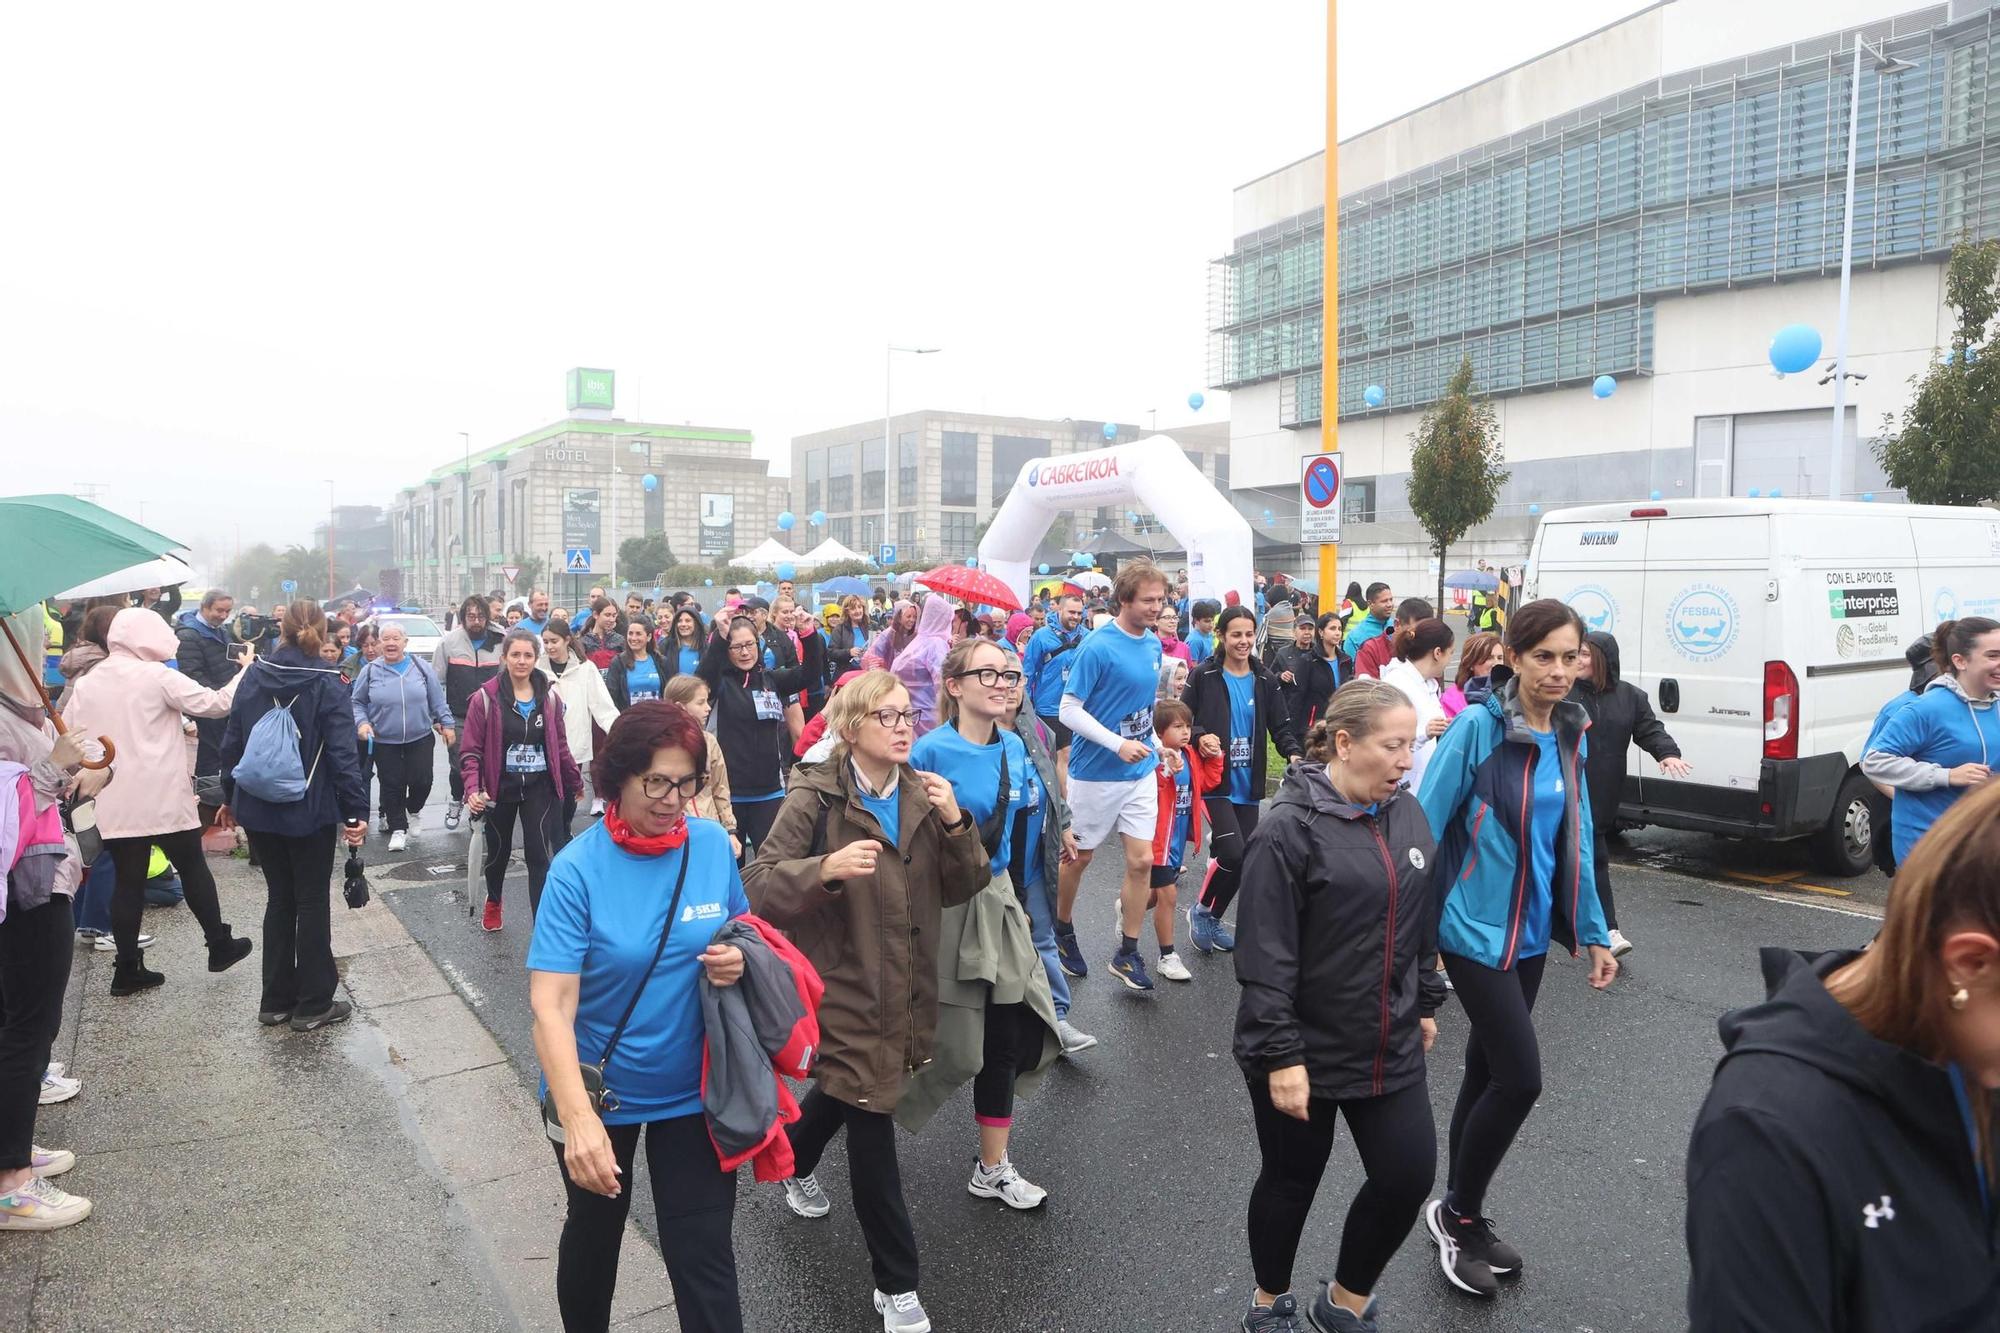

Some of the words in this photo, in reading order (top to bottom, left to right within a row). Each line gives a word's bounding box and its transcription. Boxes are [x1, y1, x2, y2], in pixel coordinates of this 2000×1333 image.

[587, 379, 606, 390] ibis
[545, 450, 590, 462] HOTEL
[1580, 532, 1618, 545] ISOTERMO
[1826, 573, 1843, 584] CON
[1846, 573, 1855, 583] EL
[1857, 572, 1882, 583] APOYO
[1830, 593, 1898, 613] enterprise
[1682, 607, 1723, 616] FESBAL
[1869, 621, 1888, 632] Global
[1858, 634, 1898, 645] FoodBanking
